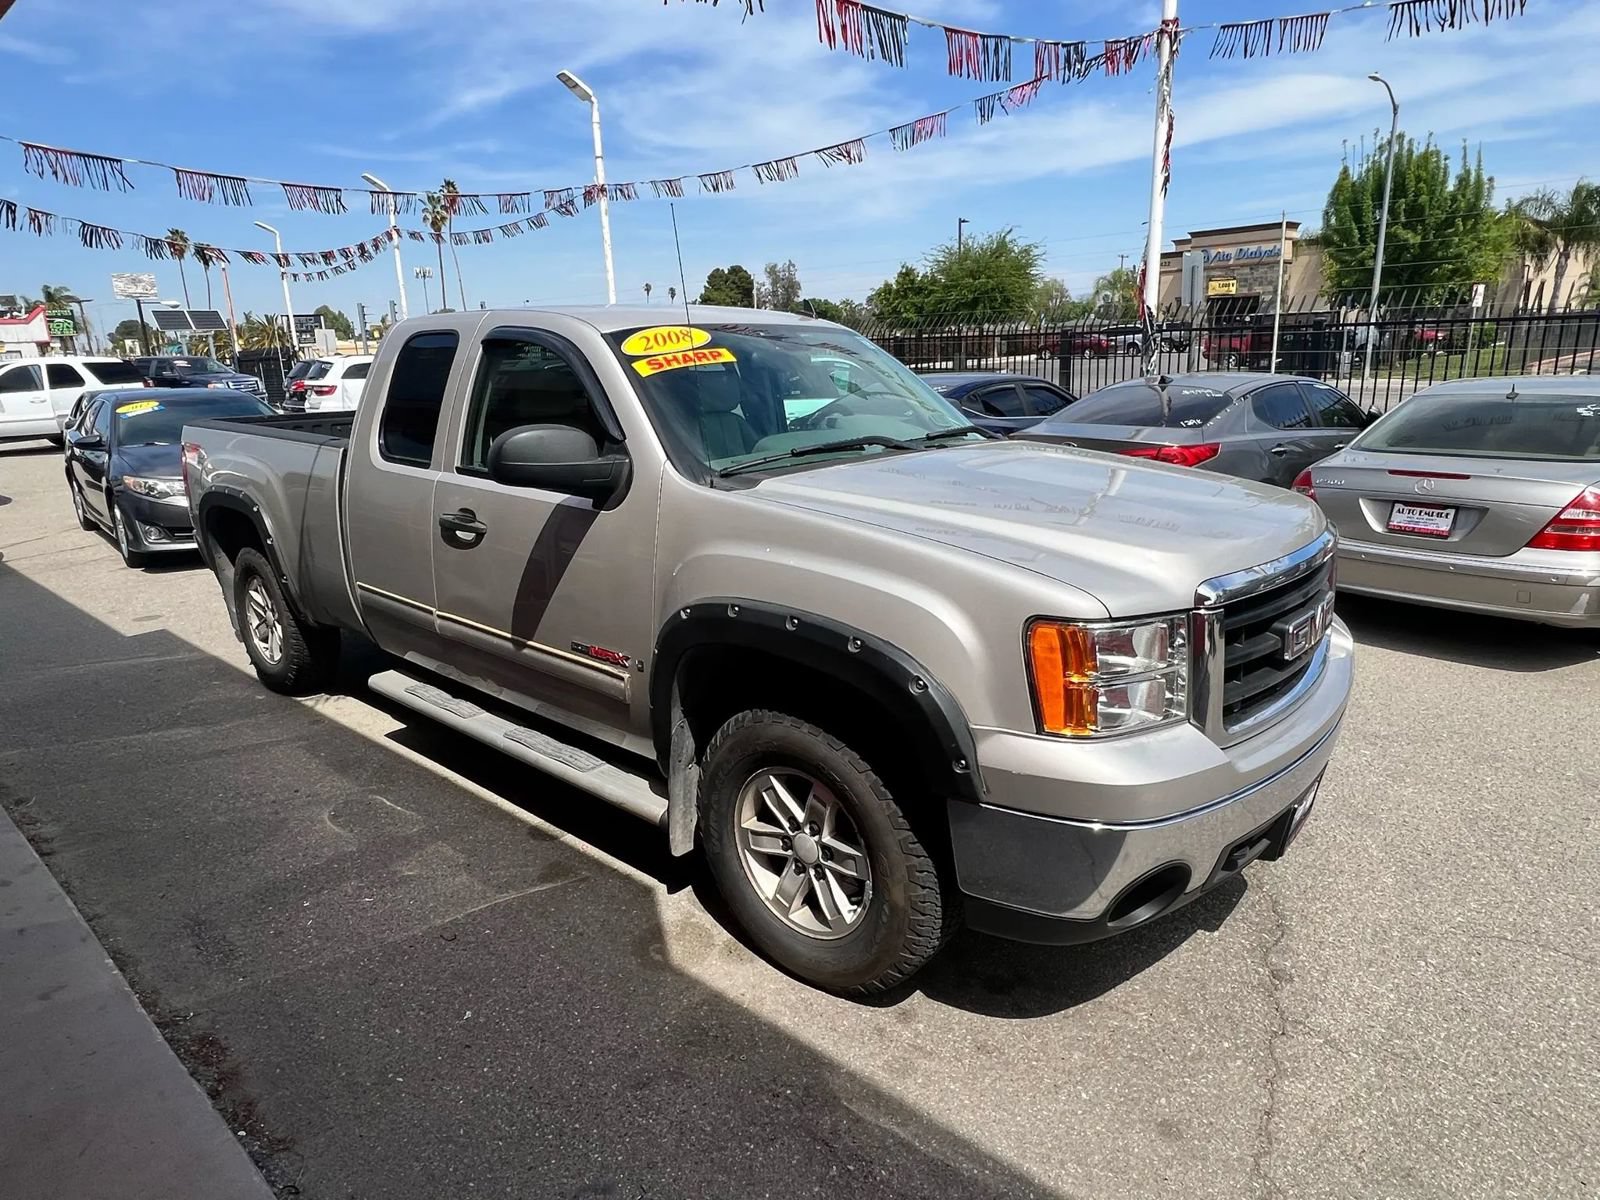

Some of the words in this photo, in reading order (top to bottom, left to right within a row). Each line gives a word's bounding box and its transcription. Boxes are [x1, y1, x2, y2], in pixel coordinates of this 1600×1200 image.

[638, 328, 692, 352] 2008
[645, 350, 723, 371] SHARP
[1396, 507, 1418, 516] AUTO
[1418, 508, 1452, 520] EMPIRE
[1284, 591, 1336, 661] GMC
